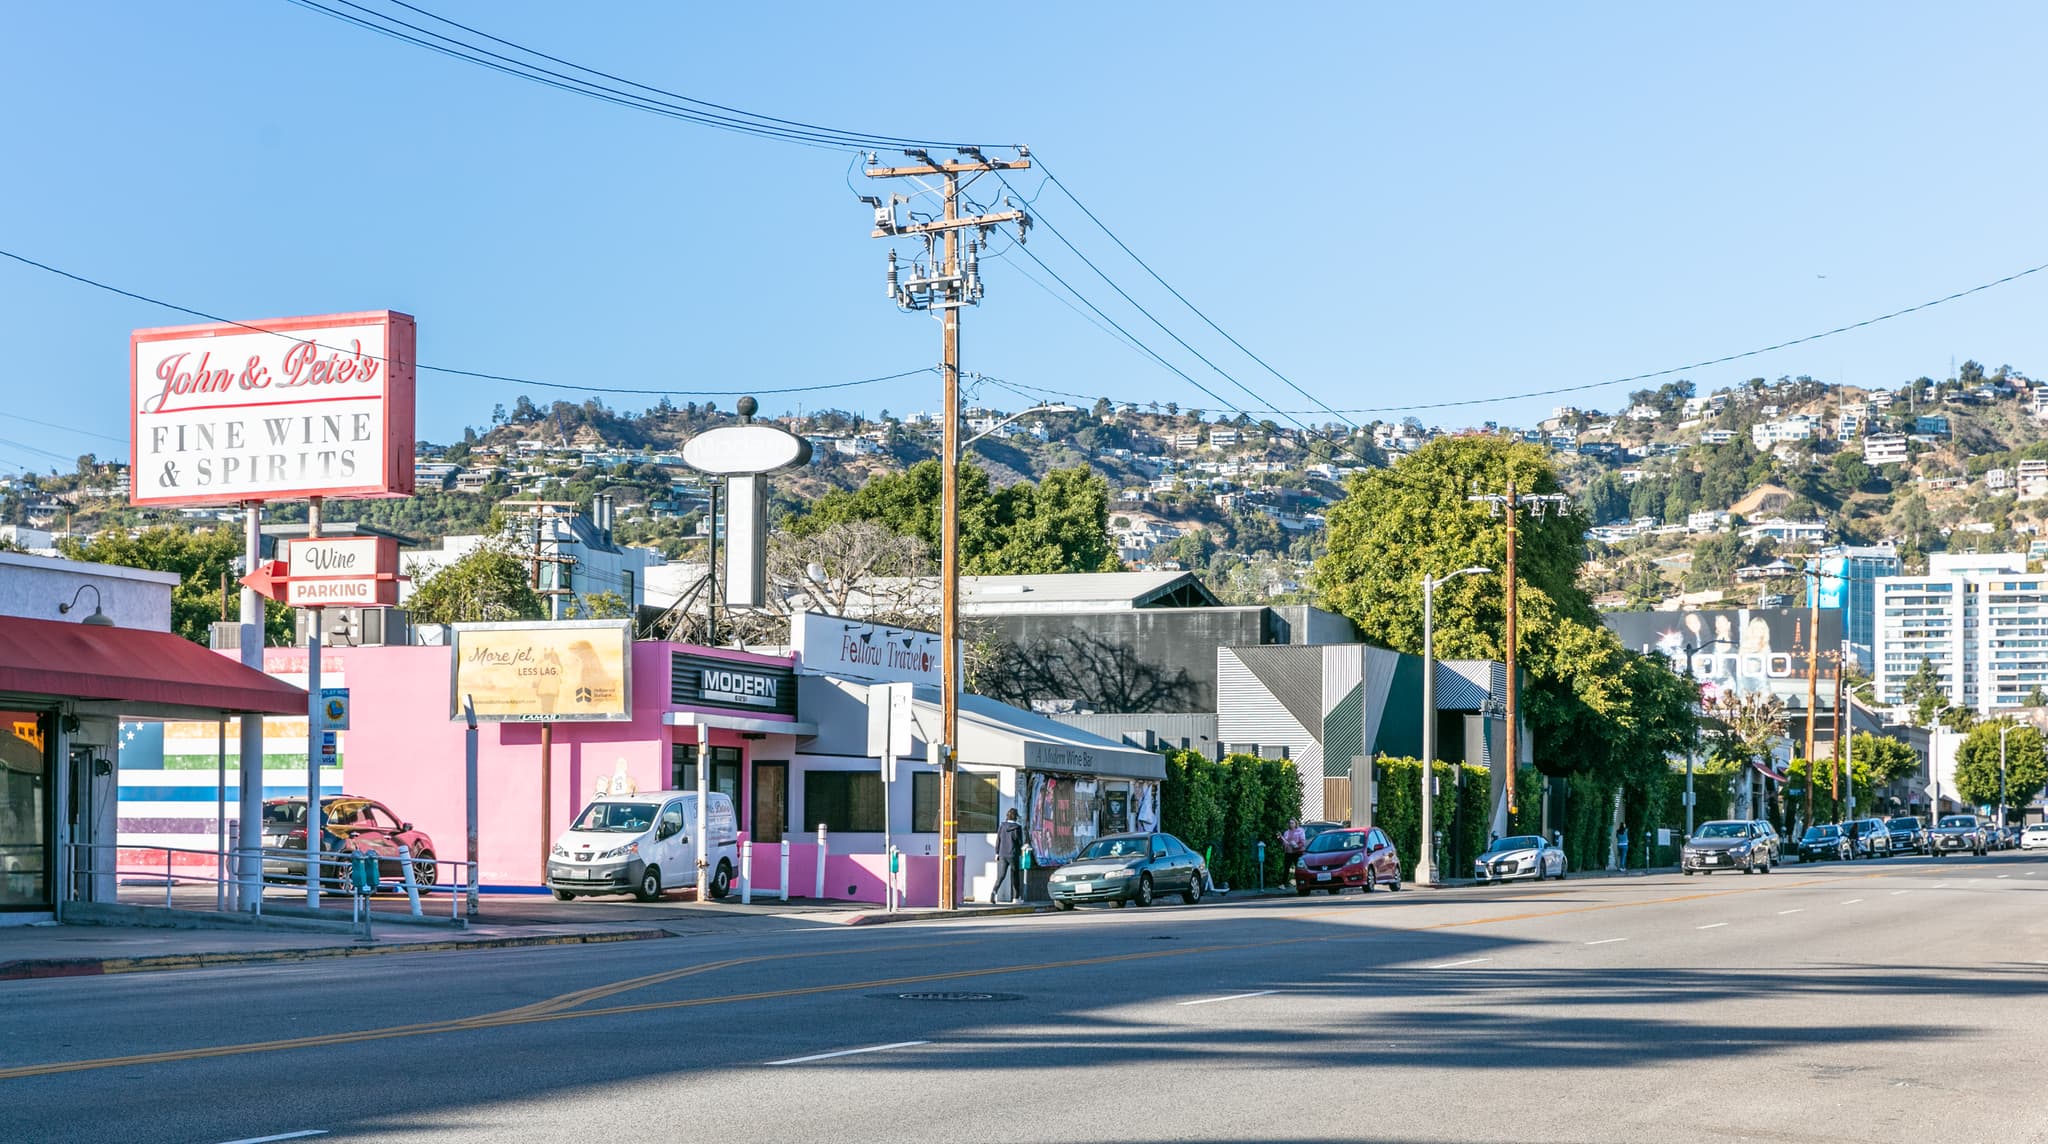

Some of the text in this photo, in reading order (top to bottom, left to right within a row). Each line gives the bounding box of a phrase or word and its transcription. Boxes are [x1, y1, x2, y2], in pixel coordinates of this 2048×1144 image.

[144, 339, 380, 414] John & Pete's
[151, 413, 372, 454] FINE WINE
[159, 449, 356, 488] & SPIRITS
[305, 546, 356, 571] Wine
[297, 583, 368, 598] PARKING
[468, 646, 536, 666] More jet,
[840, 634, 936, 673] Fellow Traveler
[518, 667, 559, 676] LESS LAG.
[704, 670, 777, 697] MODERN
[322, 756, 335, 764] VISA
[1036, 747, 1094, 768] A Modern Wine Bar
